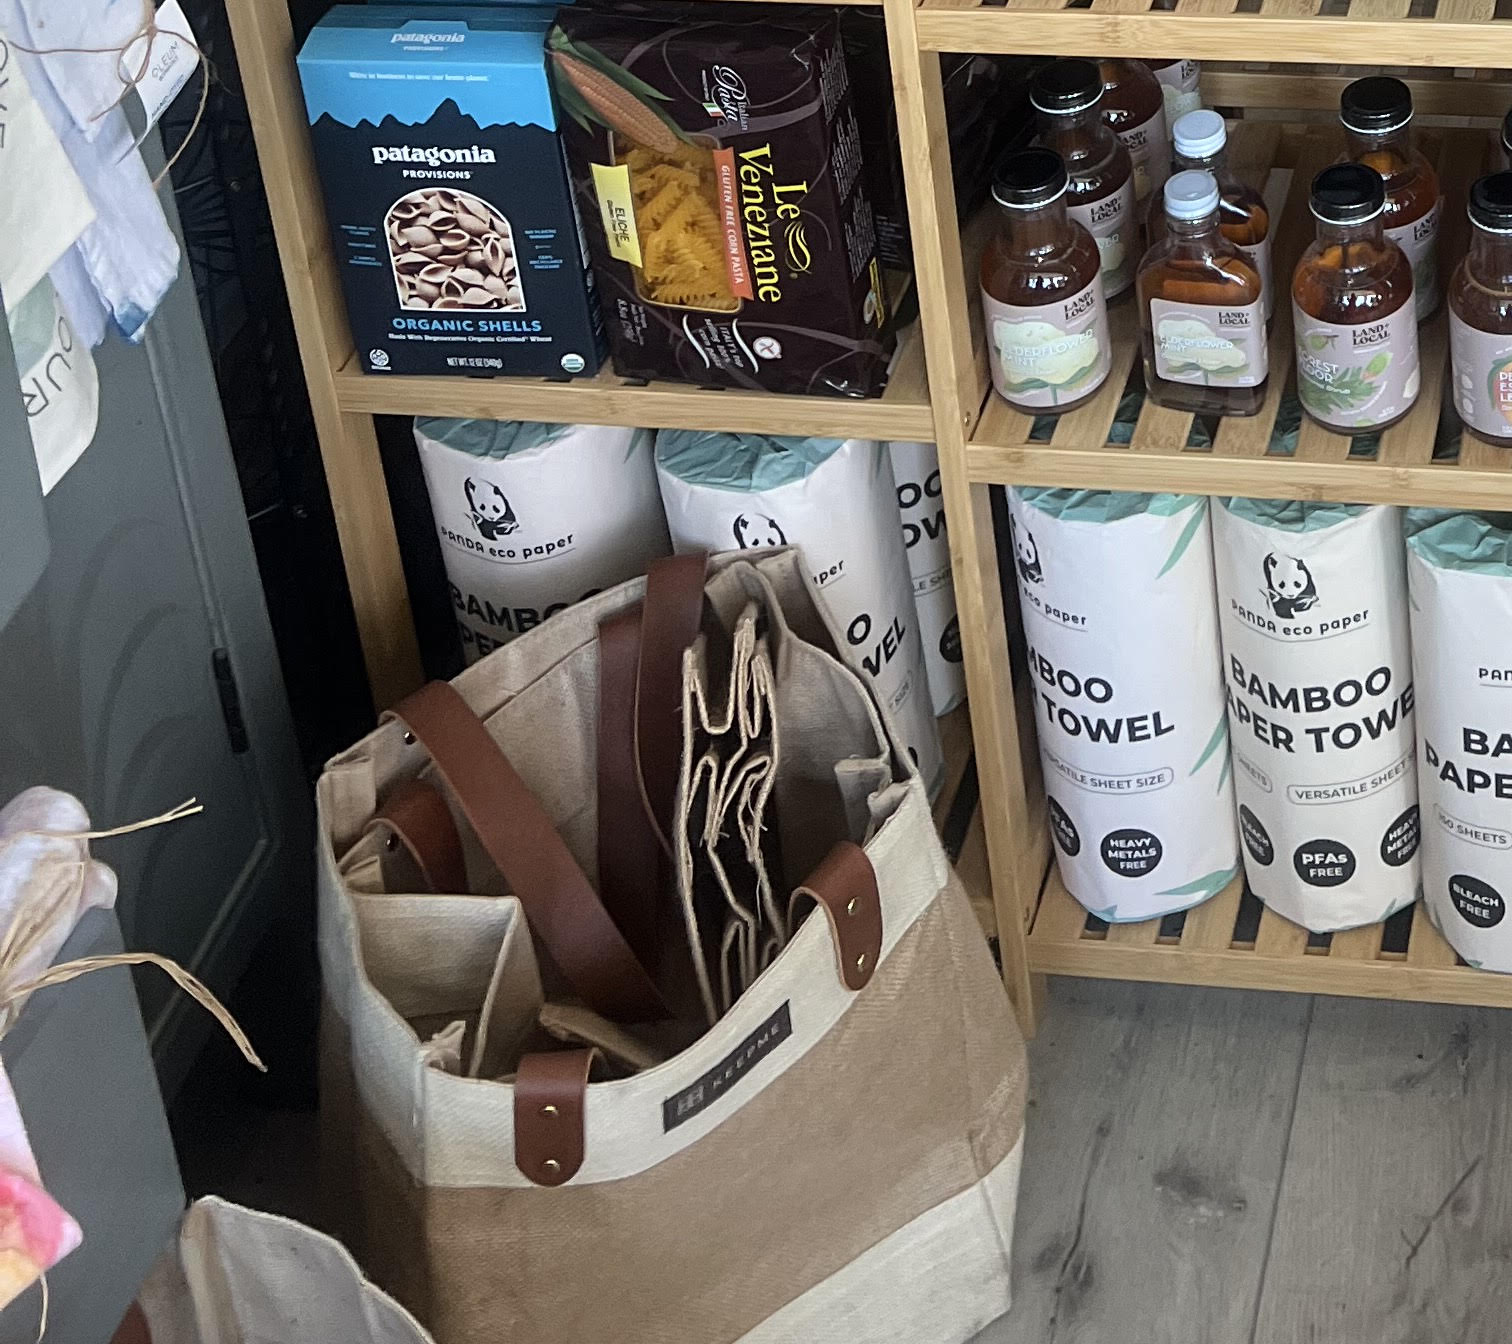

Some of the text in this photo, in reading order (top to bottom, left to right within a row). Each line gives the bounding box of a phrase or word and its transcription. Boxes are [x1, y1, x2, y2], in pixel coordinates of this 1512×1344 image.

[371, 142, 497, 168] patagonia
[771, 180, 809, 221] Le
[738, 142, 783, 304] Veneziane
[477, 318, 543, 334] SHELLS
[1231, 600, 1370, 637] PANDA eco paper
[1230, 653, 1392, 715] BAMBOO
[1041, 705, 1175, 744] TOWEL
[1090, 773, 1166, 789] SHEET SIZE
[1295, 782, 1368, 800] VERSATILE
[1107, 848, 1157, 859] METALS
[1109, 837, 1151, 849] HEAVY
[1119, 860, 1147, 870] FREE
